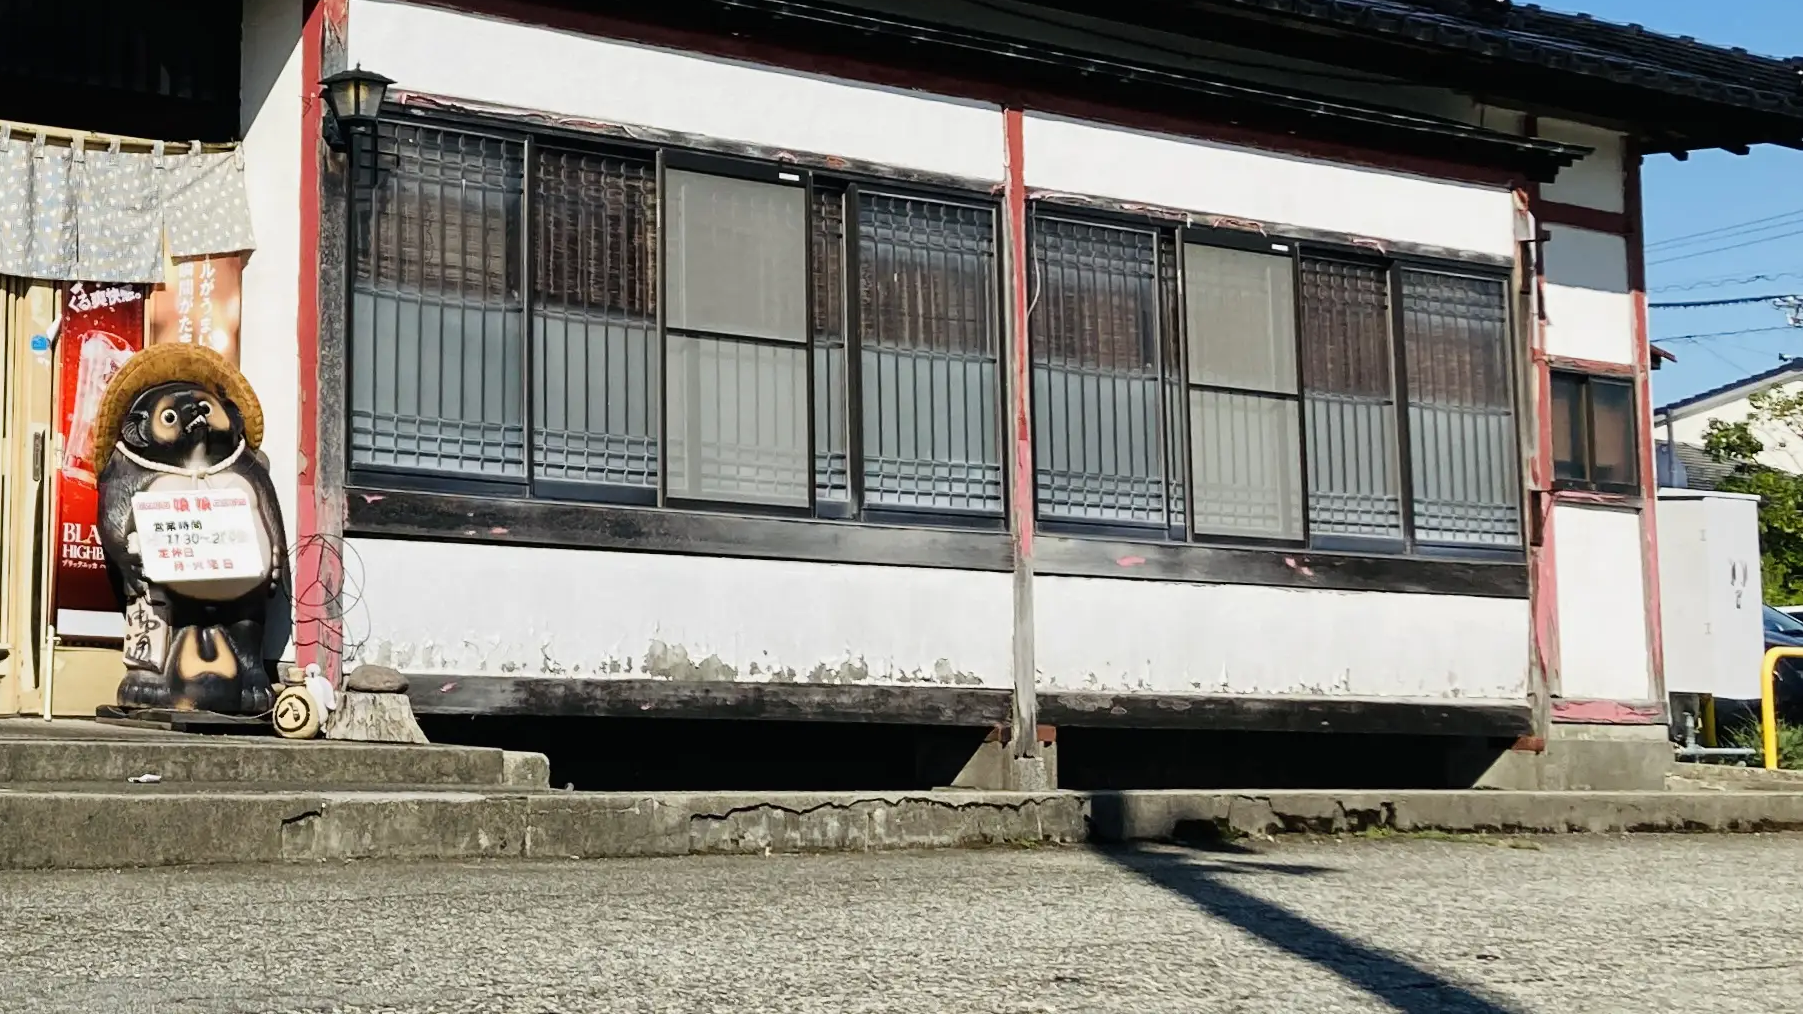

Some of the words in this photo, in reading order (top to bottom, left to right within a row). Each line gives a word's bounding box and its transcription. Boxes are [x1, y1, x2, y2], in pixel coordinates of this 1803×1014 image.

[153, 519, 203, 532] 営業時間
[158, 547, 195, 559] 定休日
